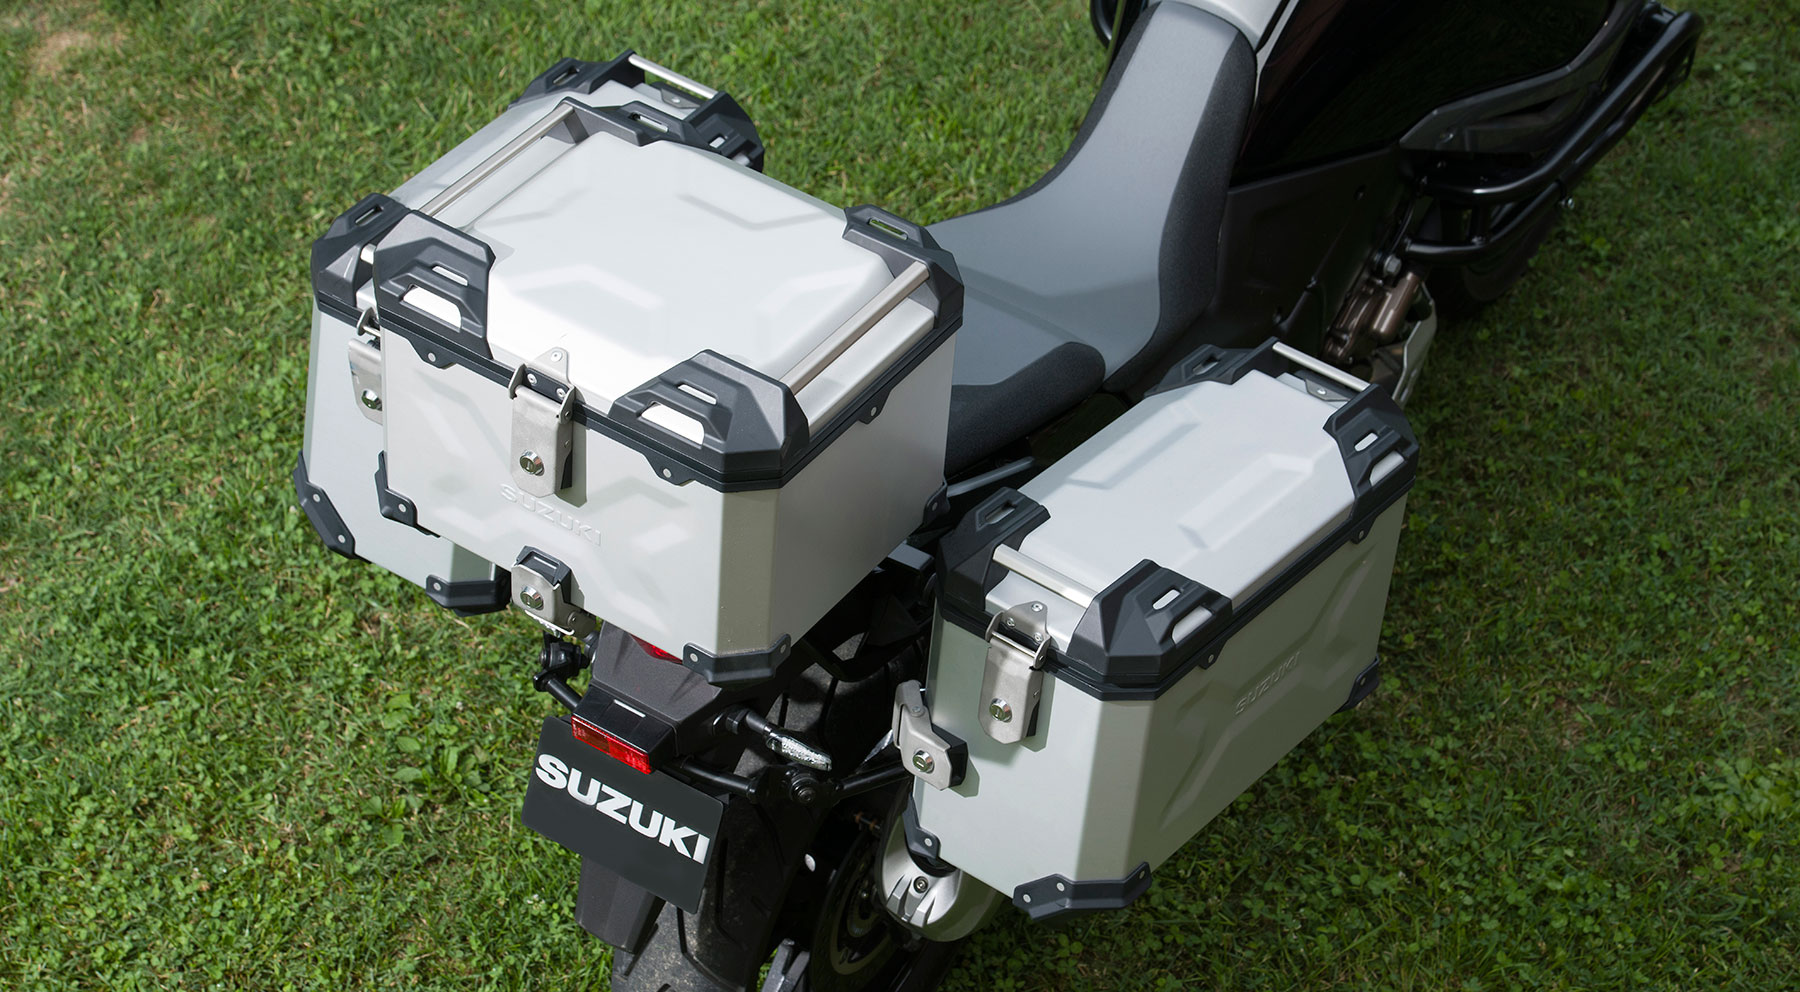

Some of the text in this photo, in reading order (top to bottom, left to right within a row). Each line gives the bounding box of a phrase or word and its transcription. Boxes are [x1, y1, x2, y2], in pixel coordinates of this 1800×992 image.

[499, 483, 602, 546] SUZUKI
[1234, 651, 1301, 716] SUZUKI
[535, 753, 711, 865] SUZUKI
